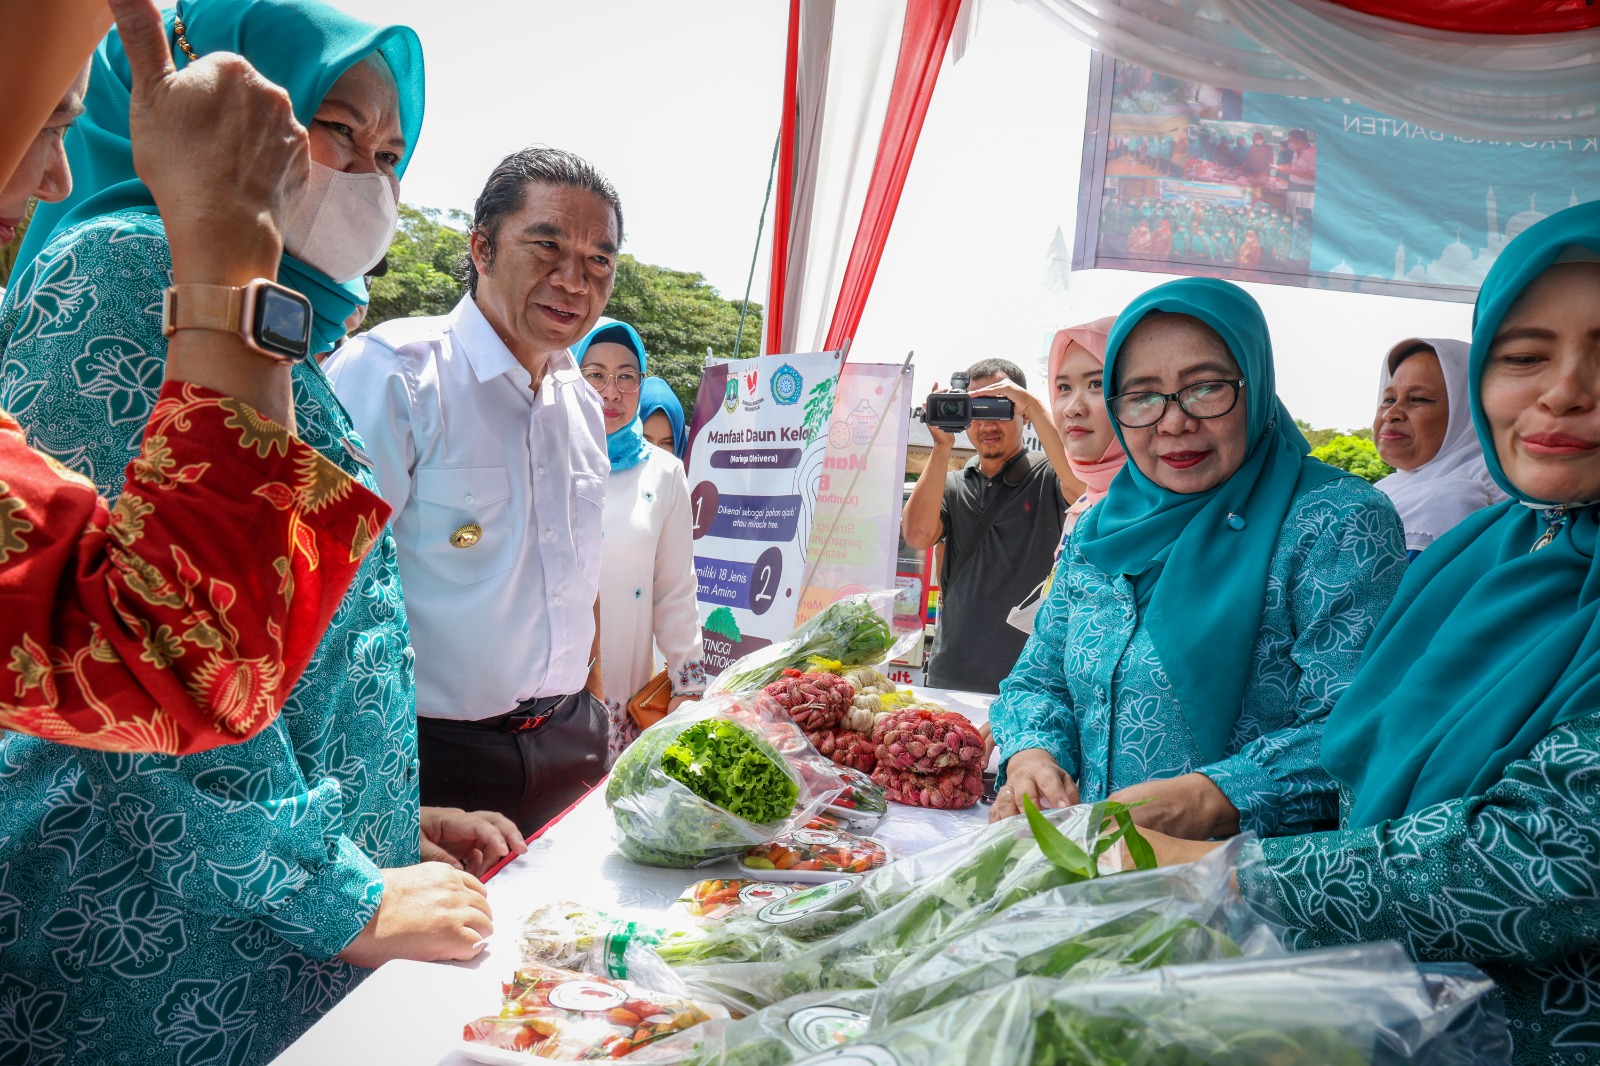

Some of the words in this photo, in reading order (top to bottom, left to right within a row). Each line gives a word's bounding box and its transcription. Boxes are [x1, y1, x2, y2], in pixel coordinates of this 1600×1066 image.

[707, 429, 744, 444] Manfaat
[746, 428, 776, 443] Daun
[780, 425, 814, 442] Kelor
[692, 496, 703, 530] 1
[717, 505, 742, 517] Dikenal
[741, 507, 765, 520] sebagai
[732, 519, 747, 528] atau
[747, 520, 768, 529] miracle
[718, 568, 728, 581] 18
[727, 570, 748, 584] Jenis
[755, 565, 772, 602] 2
[710, 584, 737, 599] Amino
[703, 638, 732, 656] TINGGI
